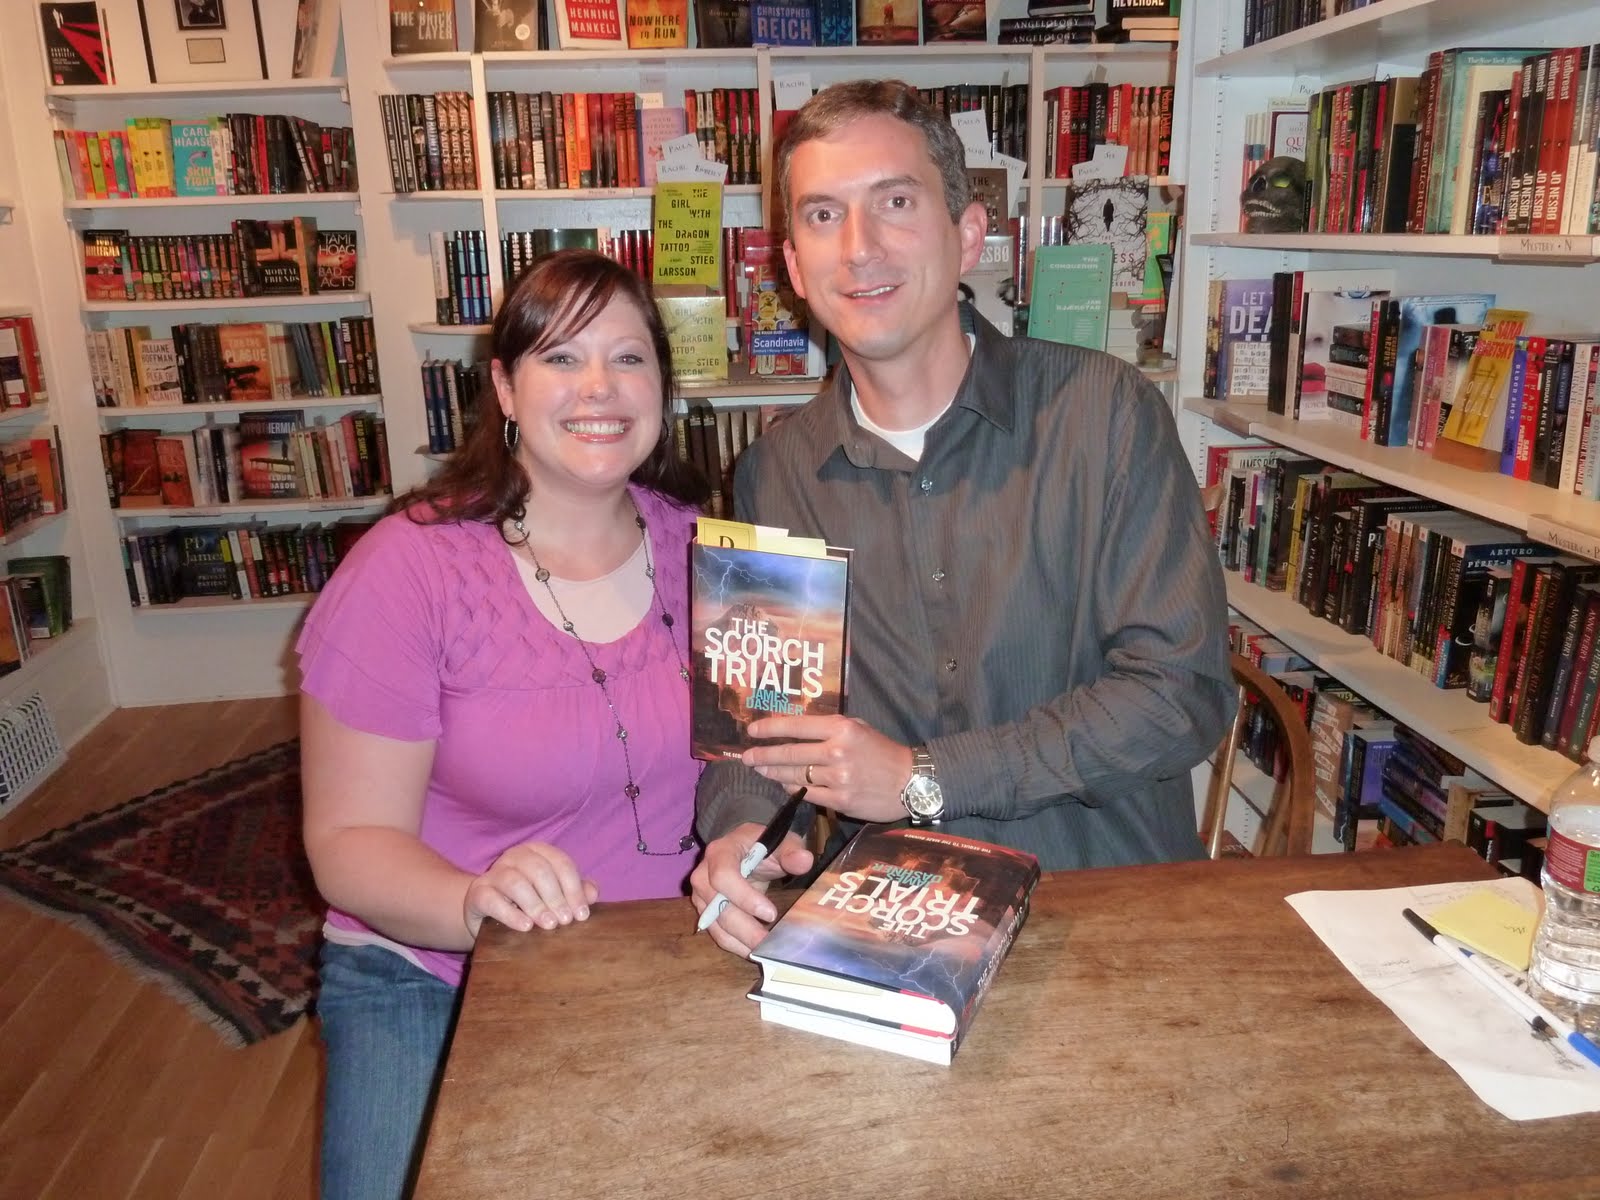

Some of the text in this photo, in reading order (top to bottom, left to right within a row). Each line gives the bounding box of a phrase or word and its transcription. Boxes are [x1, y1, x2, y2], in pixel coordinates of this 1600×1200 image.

[394, 11, 453, 26] THE BRICK
[570, 8, 615, 20] HENNING
[757, 6, 811, 17] CHRISTOPHER
[571, 21, 617, 34] MANKELL
[629, 15, 680, 27] NOWHERE
[1013, 17, 1080, 29] ANGELOLOGY
[418, 25, 453, 40] LAYER
[654, 28, 677, 39] RUN
[757, 18, 812, 40] REICH
[1012, 31, 1078, 43] ANGELOLOGY
[1522, 64, 1532, 98] nemesis
[1535, 59, 1547, 92] nemesis
[1546, 55, 1559, 100] redbreast
[1560, 54, 1574, 100] redbreast
[529, 96, 540, 114] TED
[1161, 89, 1172, 112] Nelson
[615, 98, 625, 129] VENOM
[625, 98, 635, 129] VENOM
[1425, 100, 1434, 136] MOSSE
[423, 97, 439, 156] DAVID BALDACCI
[531, 115, 542, 138] BELL
[1060, 109, 1071, 134] CRAIS
[183, 127, 209, 138] CARL
[440, 110, 451, 164] THE VAULTS
[449, 110, 461, 164] THE VAULTS
[460, 110, 471, 164] THE VAULTS
[668, 143, 694, 154] PAULA
[186, 167, 212, 177] SKIN
[1415, 140, 1431, 217] SEPULCHRE
[1523, 172, 1534, 185] JO
[1536, 170, 1548, 183] JO
[1550, 170, 1562, 184] JO
[184, 177, 216, 187] TIGHT
[973, 176, 990, 186] THE
[1511, 176, 1521, 189] JO
[692, 188, 708, 198] THE
[671, 199, 690, 208] GIRL
[689, 209, 711, 218] WITH
[658, 219, 673, 228] THE
[324, 233, 353, 245] TAMI
[675, 229, 710, 239] DRAGON
[319, 244, 356, 256] HOAG
[660, 243, 690, 252] TATTOO
[1564, 239, 1572, 251] N
[690, 255, 714, 264] STIEG
[264, 268, 298, 276] MORTAL
[320, 267, 344, 278] BAD
[659, 267, 696, 276] LARSSON
[265, 276, 300, 284] FRIENDS
[320, 276, 355, 288] ACTS
[1242, 291, 1265, 306] LET
[675, 308, 692, 316] GIRL
[692, 317, 713, 325] WITH
[1498, 321, 1526, 339] SARA
[681, 334, 713, 343] DRAGON
[753, 336, 804, 348] Scandinavia
[671, 346, 696, 355] ATTOO
[696, 358, 720, 366] STIEG
[1570, 361, 1582, 405] PARKER
[1509, 364, 1521, 420] BLOOD SHOT
[1520, 384, 1530, 420] TIME
[1526, 384, 1536, 422] HARD
[1539, 370, 1552, 437] GUARDIAN ANGEL
[1515, 425, 1526, 461] PARETSKY
[1521, 439, 1530, 461] SARA
[1587, 419, 1599, 479] COLD SERVICE
[1240, 457, 1262, 468] JAMES
[1354, 505, 1365, 562] GEORGE PELECANOS
[719, 535, 735, 548] D
[1490, 547, 1533, 556] ARTURO
[1306, 547, 1316, 587] PEARS
[1453, 573, 1461, 587] SUN
[732, 617, 769, 637] THE
[1561, 606, 1580, 659] ANNE PERRY
[1578, 608, 1596, 661] ANNE PERRY
[704, 627, 825, 670] SCORCH
[1587, 649, 1600, 684] PERRY
[704, 652, 823, 698] TRIALS
[752, 688, 789, 704] JAMES
[746, 697, 804, 716] DASHNER
[959, 843, 980, 852] SEQUEL
[872, 862, 943, 884] DASHNER
[885, 872, 933, 888] JAMES
[832, 871, 980, 924] TRIALS
[818, 887, 973, 936] SCORCH
[878, 921, 928, 939] THE
